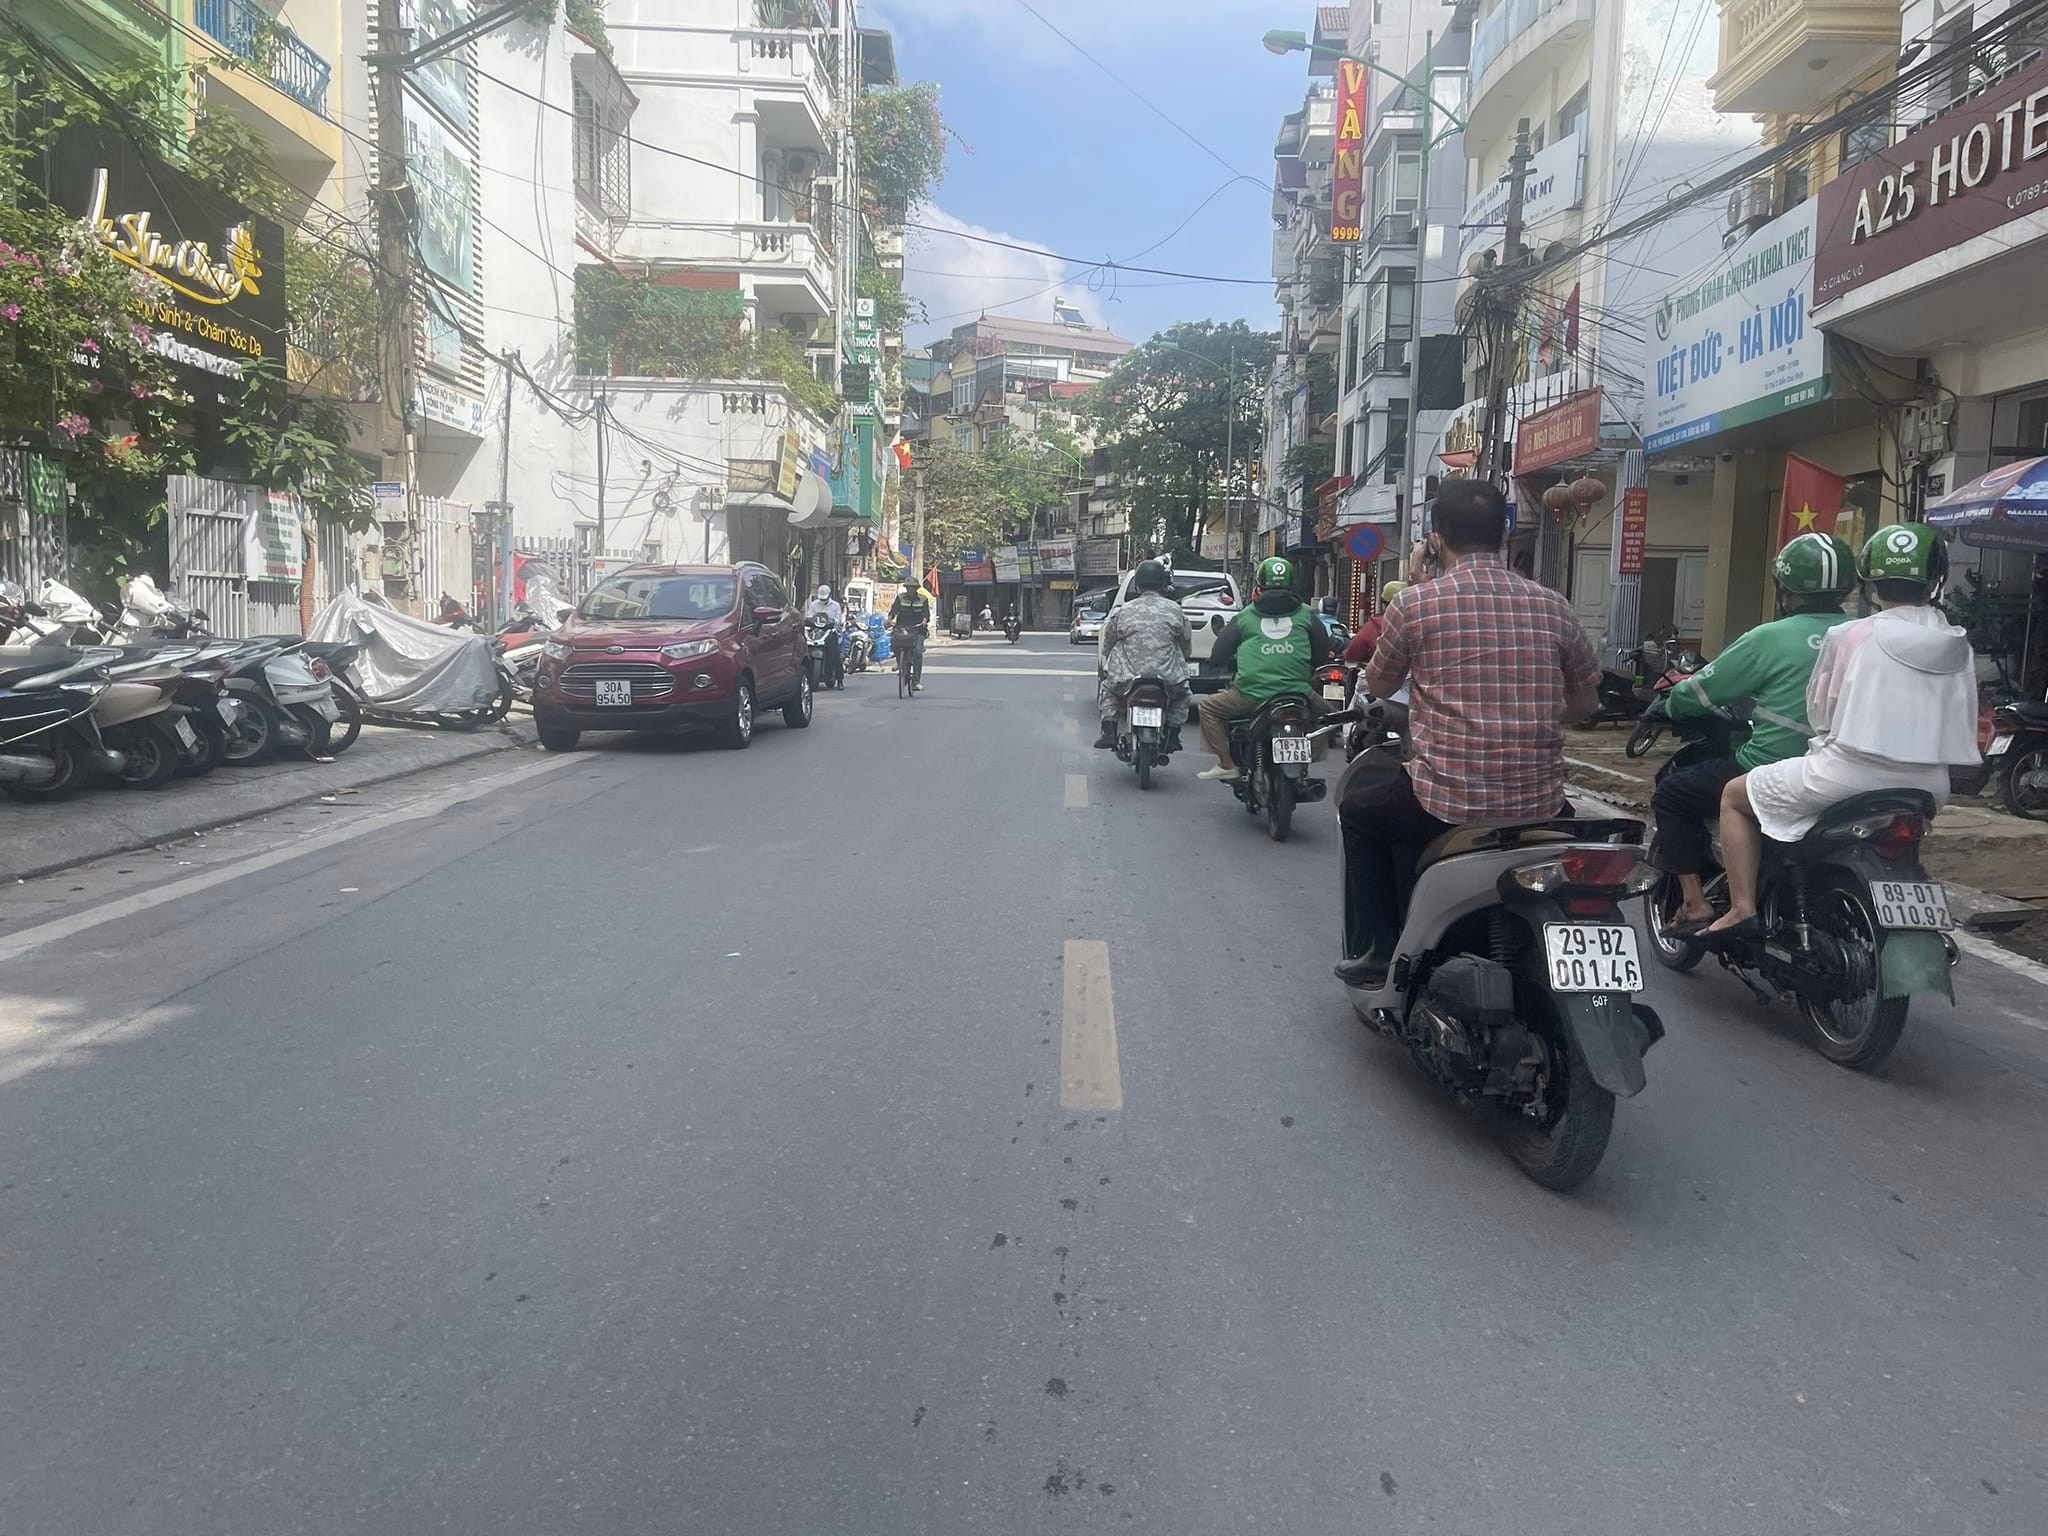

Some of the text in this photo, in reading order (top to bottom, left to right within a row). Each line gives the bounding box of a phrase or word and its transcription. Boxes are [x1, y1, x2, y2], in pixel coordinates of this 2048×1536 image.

[1336, 63, 1365, 220] VÀNG
[1851, 161, 1915, 246] A25
[2016, 184, 2040, 206] 0789
[1332, 227, 1360, 240] 9999
[1676, 287, 1700, 324] PHÒNG
[1726, 252, 1758, 298] CHUYÊN
[1759, 241, 1783, 281] KHOA
[1786, 226, 1810, 268] YHCT
[158, 302, 181, 328] Sinh
[184, 312, 193, 332] &
[198, 317, 227, 345] Chăm
[230, 326, 247, 351] Sóc
[249, 335, 262, 357] Da
[858, 319, 872, 331] NHÀ
[855, 334, 877, 347] THUỐC
[1657, 345, 1687, 401] VIỆT
[1690, 328, 1722, 384] ĐỨC
[1739, 304, 1764, 364] HÀ
[1769, 288, 1804, 356] NỘI
[1885, 556, 1912, 565] gojek
[1261, 640, 1294, 655] Grab
[604, 682, 623, 693] 30A
[597, 693, 630, 705] 954.50
[1279, 750, 1307, 761] 1766
[1882, 884, 1936, 904] 89-D1
[1882, 905, 1949, 927] 010.92
[1559, 928, 1626, 955] 29-B2
[1555, 959, 1638, 988] 001.46
